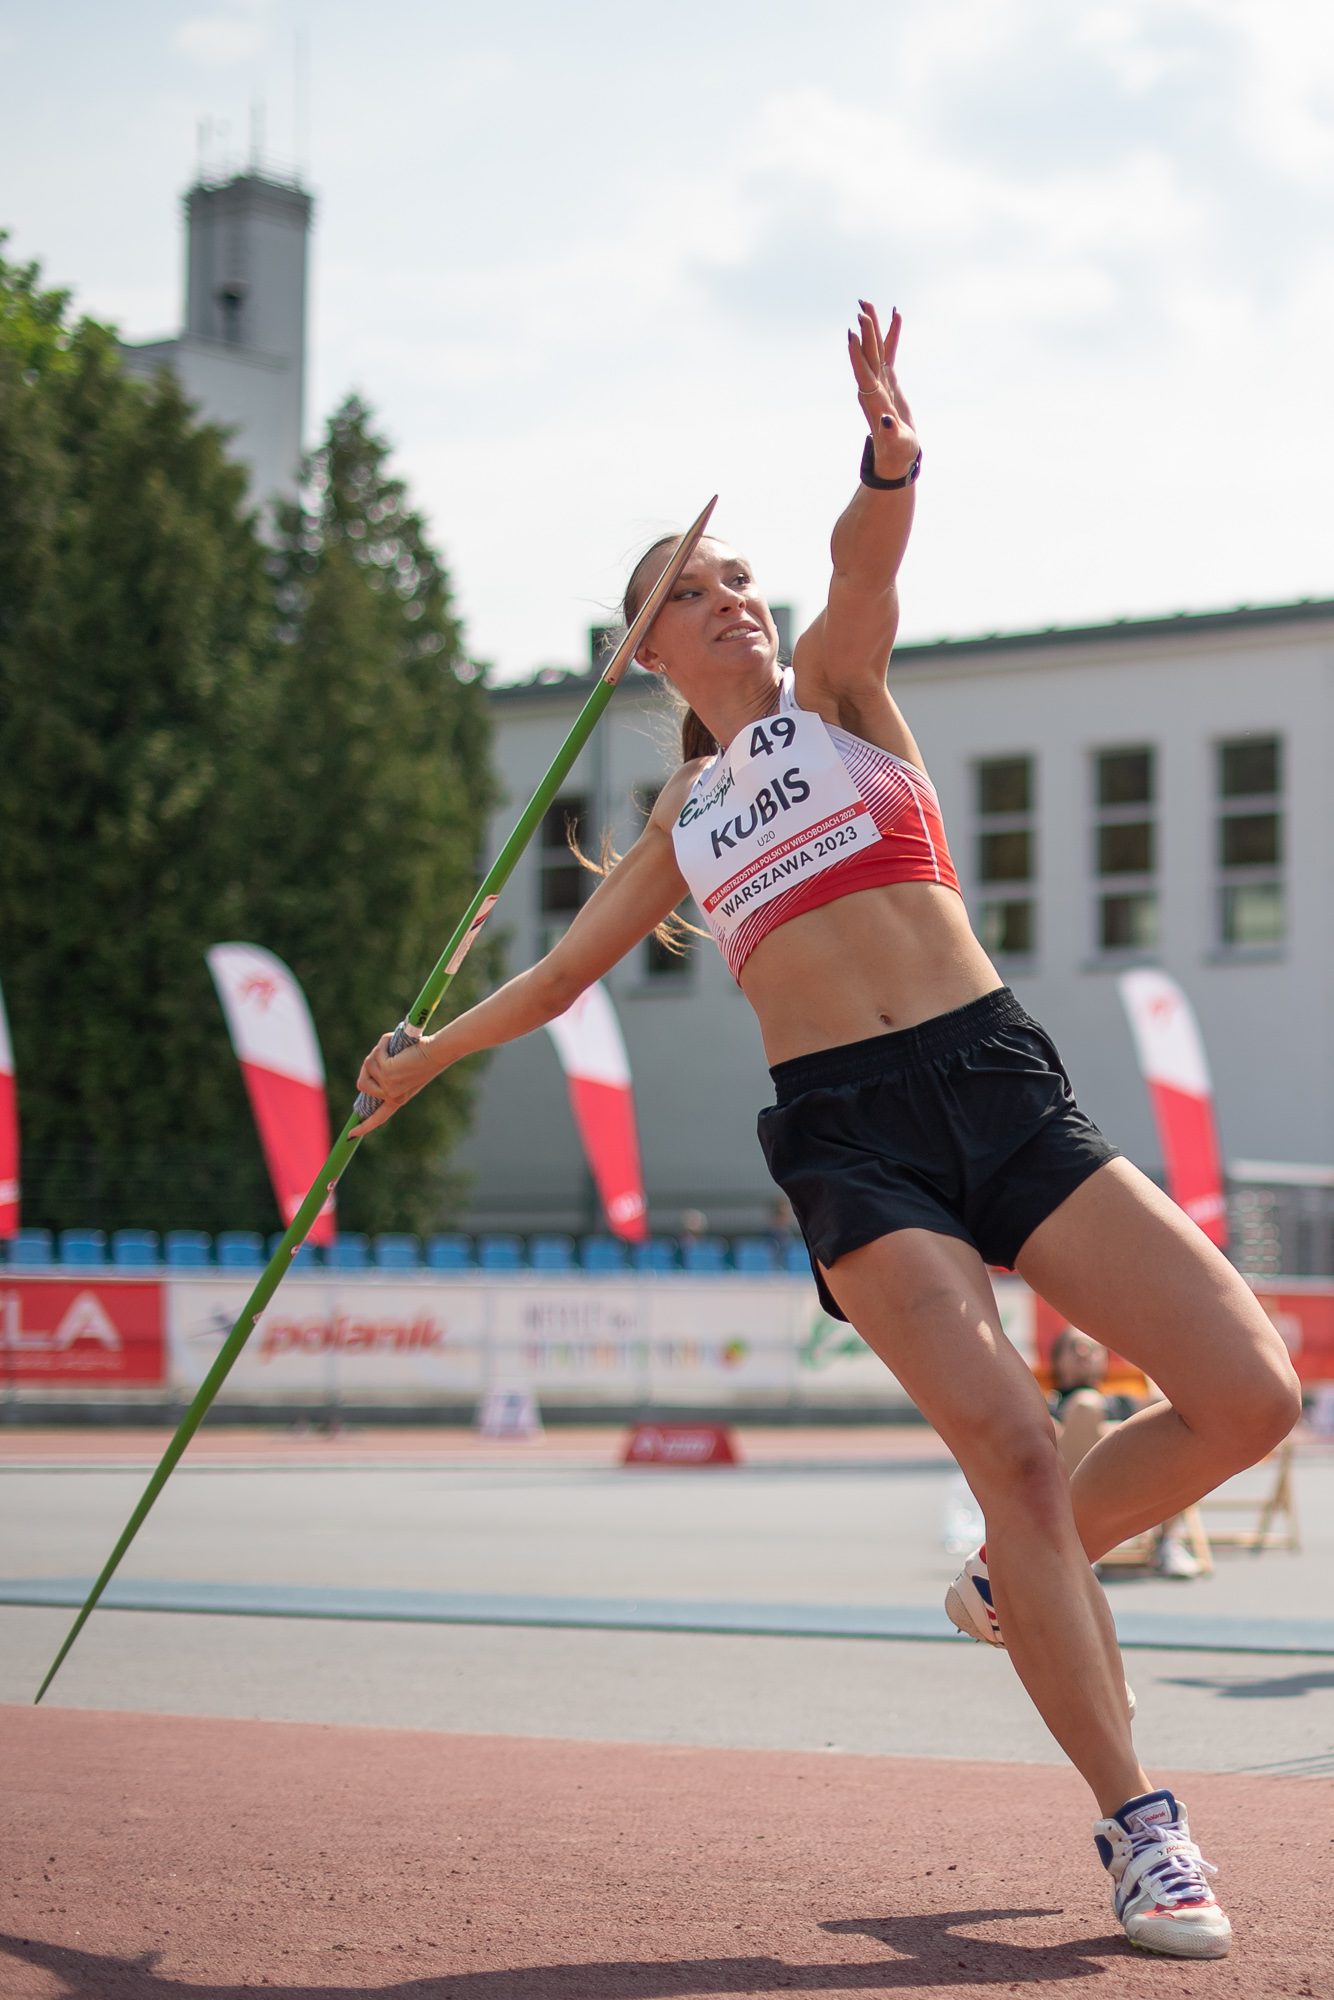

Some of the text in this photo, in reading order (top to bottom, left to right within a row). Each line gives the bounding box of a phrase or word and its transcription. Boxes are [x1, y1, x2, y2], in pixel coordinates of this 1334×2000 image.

[750, 717, 796, 758] 49
[703, 774, 727, 802] INTER
[711, 768, 810, 859] KUBIS
[709, 808, 856, 906] PZLA MISTRZOSTWA POLSKI W WIELOBOJACH 2023
[757, 830, 776, 847] U20
[721, 825, 858, 918] WARSZAWA 2023
[0, 1289, 124, 1352] LA
[258, 1307, 448, 1367] polanik
